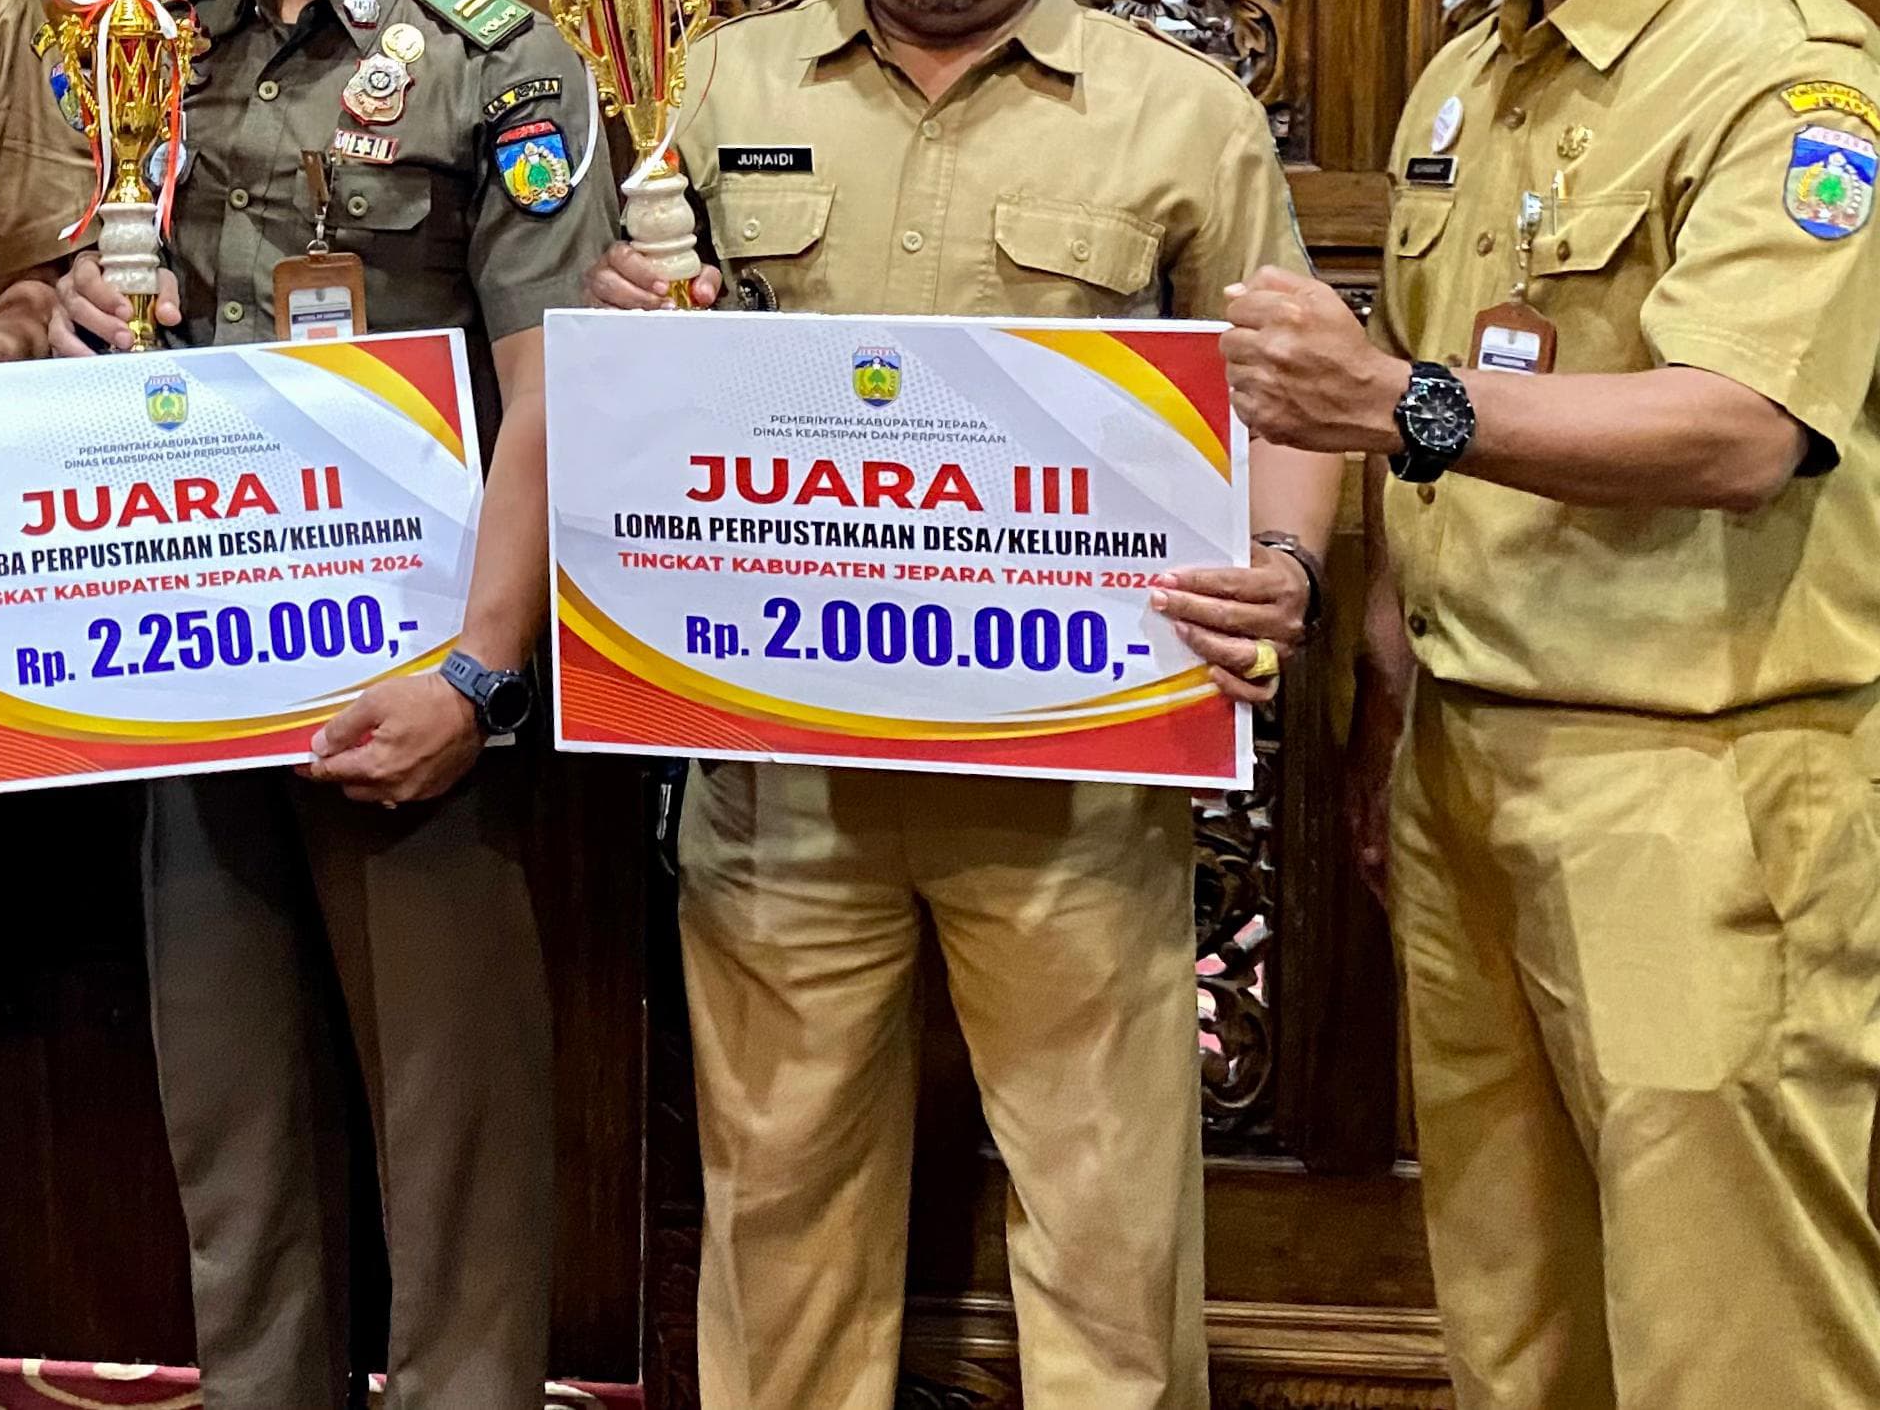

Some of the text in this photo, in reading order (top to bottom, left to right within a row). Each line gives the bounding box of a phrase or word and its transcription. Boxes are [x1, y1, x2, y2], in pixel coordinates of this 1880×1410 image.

[736, 153, 794, 167] JUNAIDI
[79, 431, 264, 456] PEMERINTAH KABUPATEN JEPARA
[753, 427, 1007, 444] DINAS KEARSIPAN DAN PERPUSTAKAAN
[770, 415, 987, 430] PEMERINTAH KABUPATEN JEPARA
[64, 442, 281, 470] DINAS KEARSIPAN DAN PERPUSTAKAAN
[21, 466, 343, 536] JUARA II
[685, 455, 1089, 515] JUARA III
[31, 533, 213, 576] PERPUSTAKAAN
[218, 516, 423, 561] DESA/KELURAHAN
[614, 512, 1167, 559] LOMBA PERPUSTAKAAN DESA/KELURAHAN
[54, 574, 190, 600] KABUPATEN
[197, 566, 284, 587] JEPARA
[287, 559, 364, 579] TAHUN
[371, 554, 423, 572] 2024
[617, 552, 725, 572] TINGKAT
[732, 557, 886, 579] KABUPATEN
[893, 564, 996, 584] JEPARA
[1001, 568, 1093, 587] TAHUN
[16, 594, 419, 688] Rp. 2.250.000,-
[686, 597, 1150, 681] Rp. 2.000.000,-
